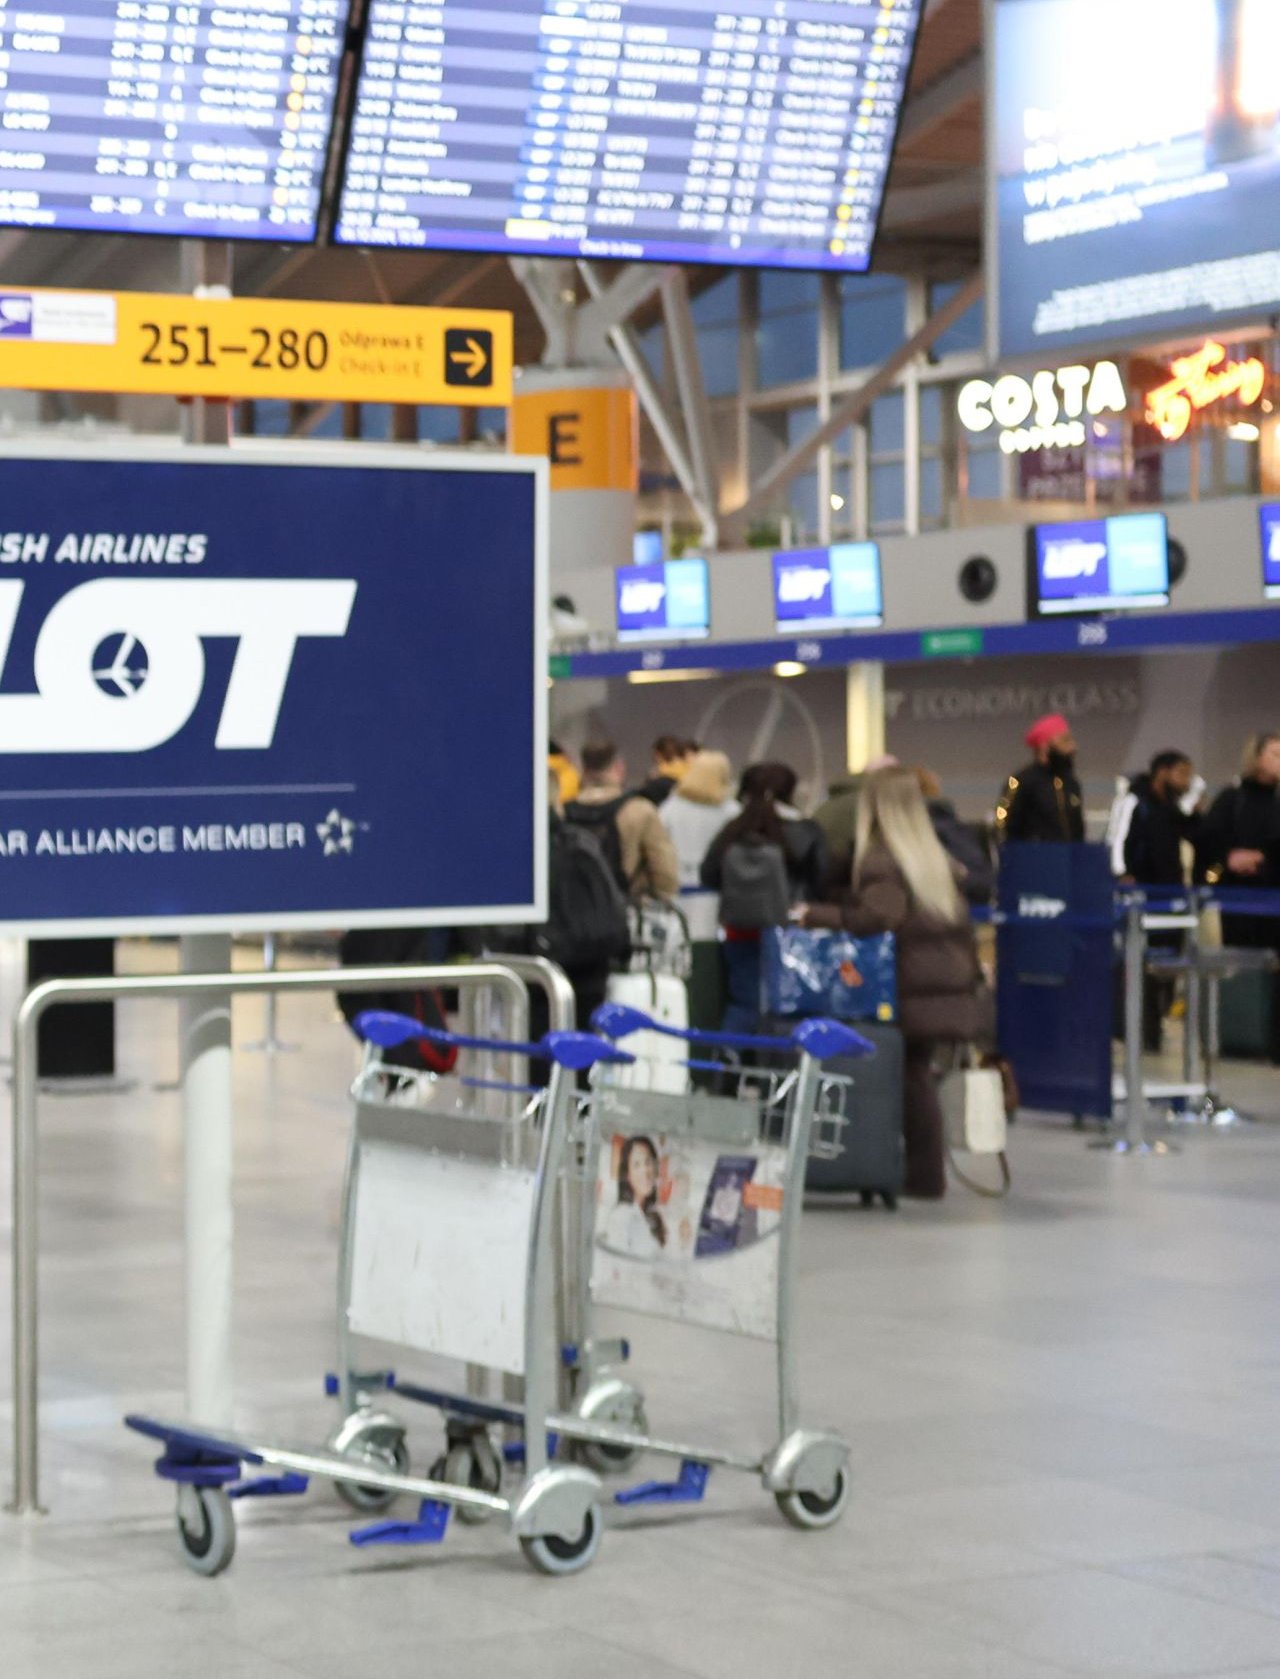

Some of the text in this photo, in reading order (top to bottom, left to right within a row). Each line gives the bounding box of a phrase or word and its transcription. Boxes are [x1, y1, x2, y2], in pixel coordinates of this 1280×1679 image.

[957, 360, 1128, 432] COSTA
[547, 413, 582, 467] E
[54, 533, 207, 564] AIRLINES
[35, 826, 176, 855] ALLIANCE
[182, 822, 305, 851] MEMBER
